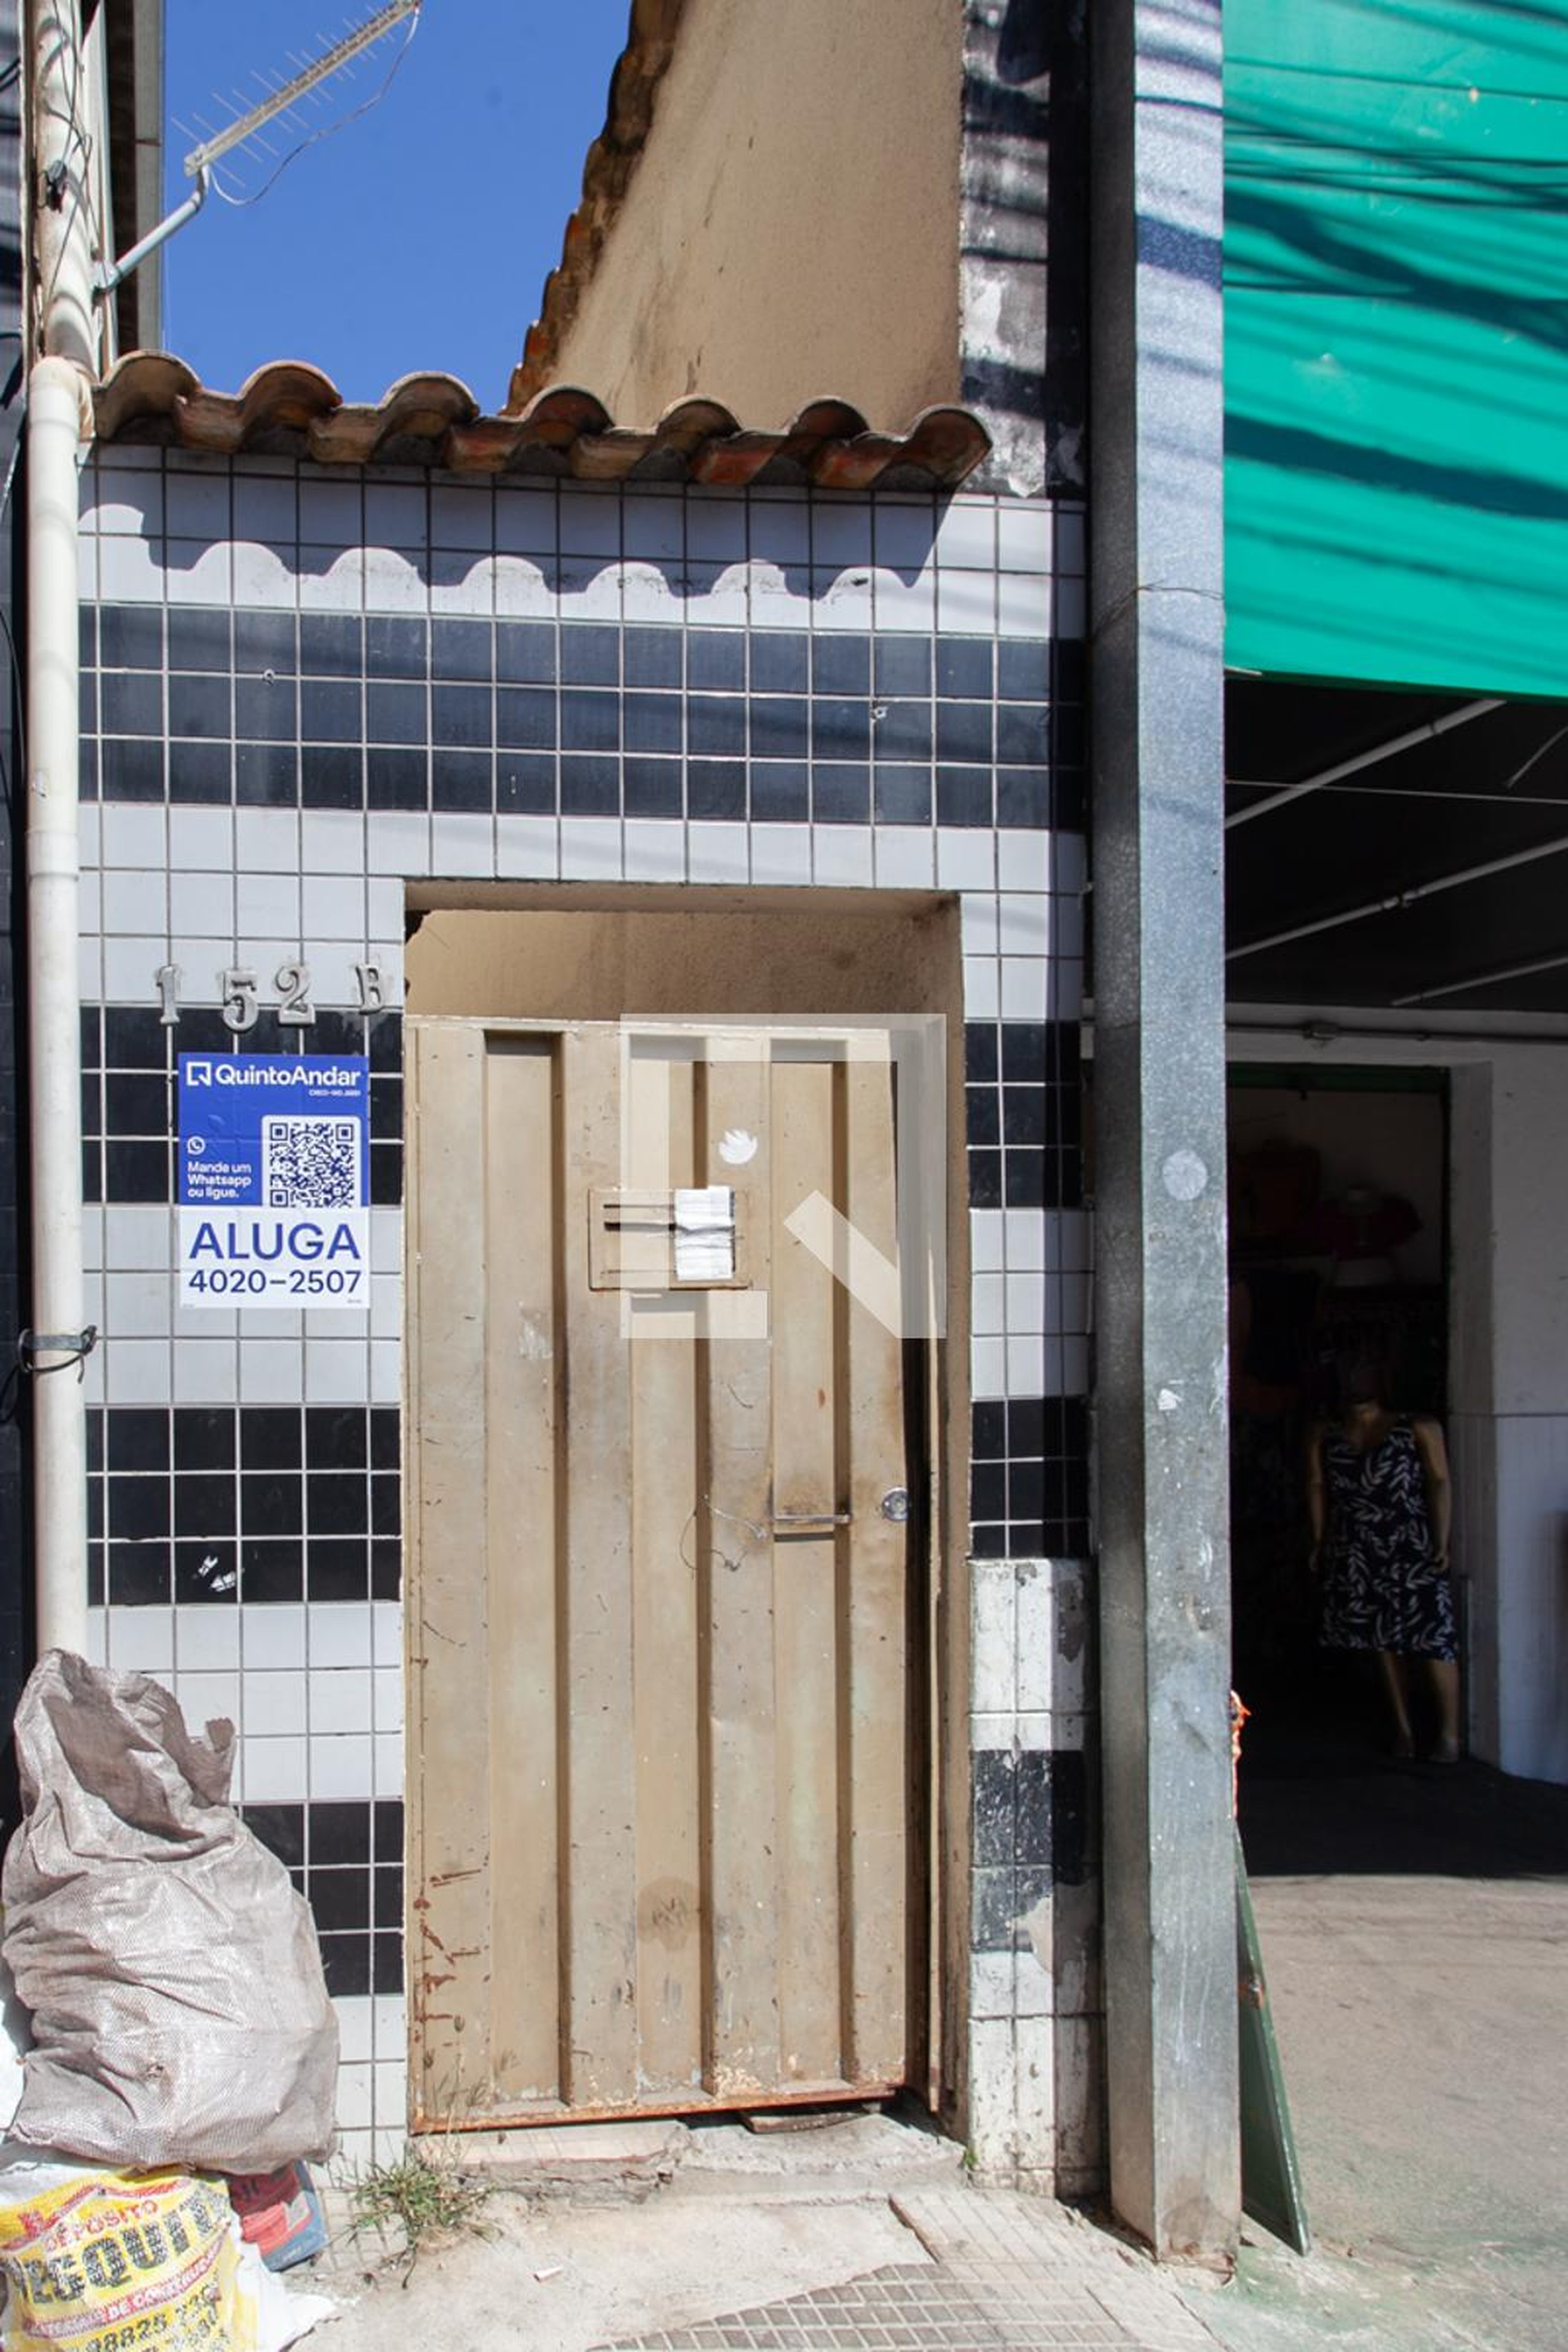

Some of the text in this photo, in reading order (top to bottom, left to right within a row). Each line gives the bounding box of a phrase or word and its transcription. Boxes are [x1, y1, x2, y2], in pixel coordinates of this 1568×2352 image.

[154, 965, 316, 1033] 152
[215, 1063, 361, 1086] QuintoAndar
[231, 1163, 252, 1174] um
[187, 1187, 204, 1197] ou
[189, 1223, 361, 1260] ALUGA
[189, 1269, 361, 1294] 4020-2507
